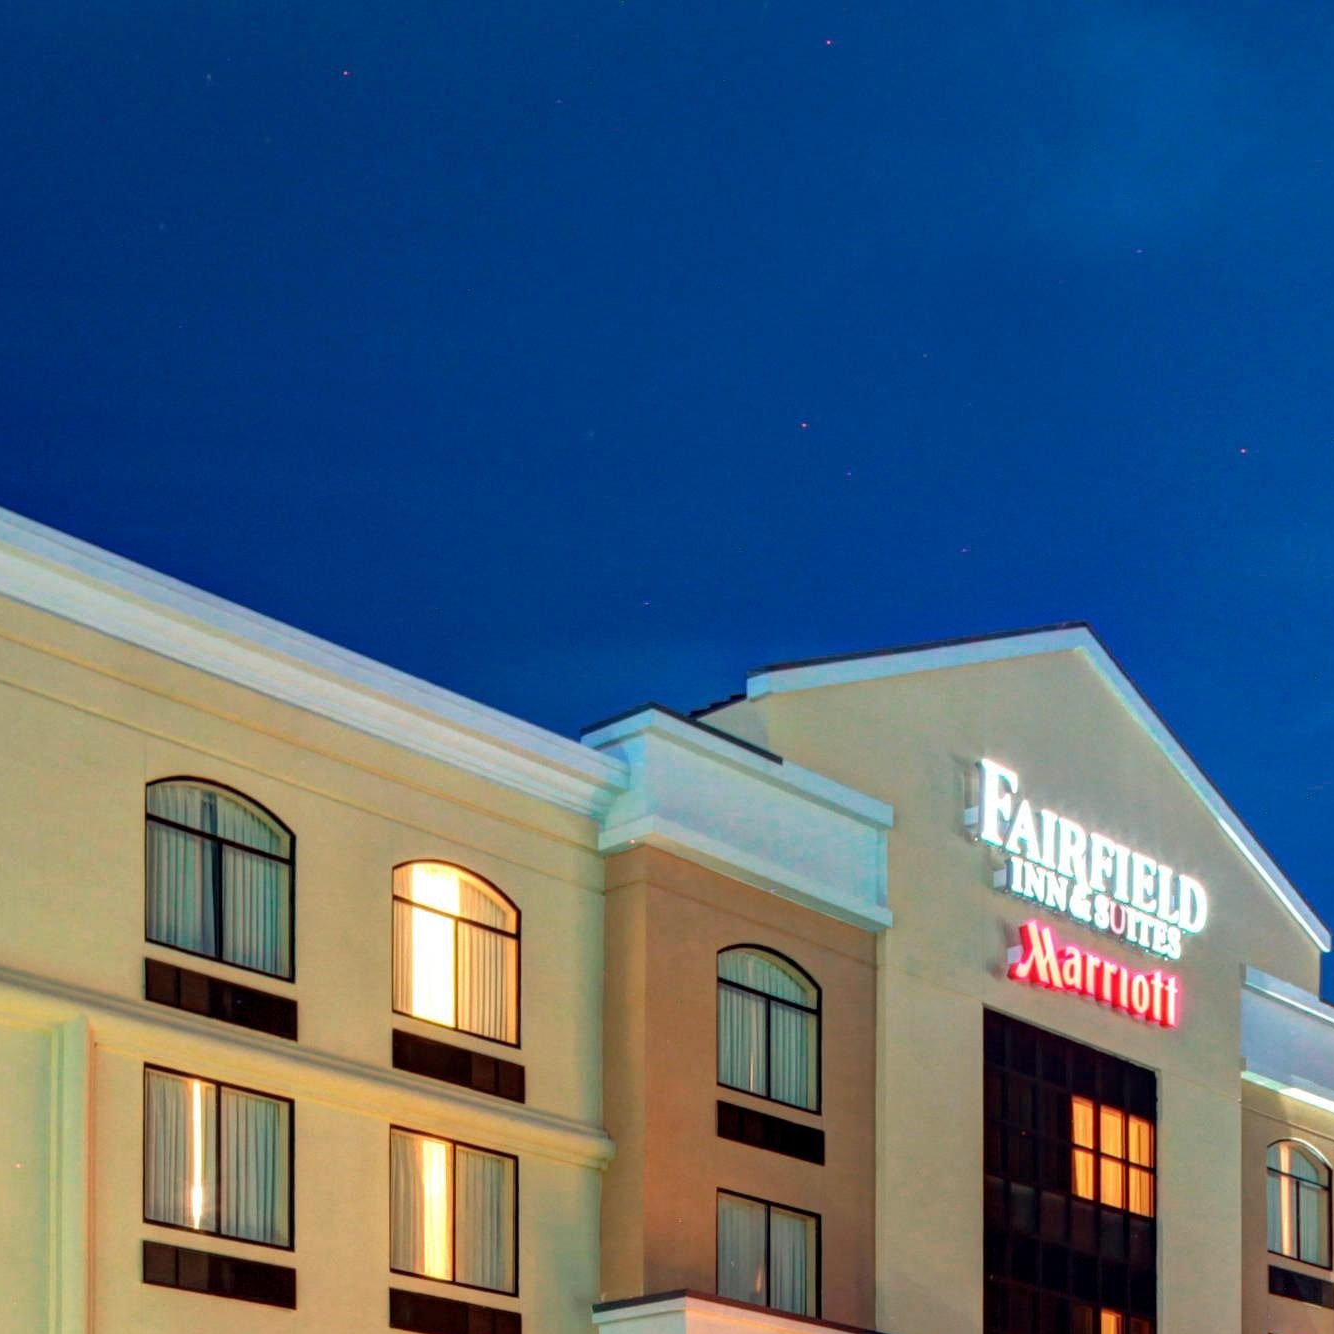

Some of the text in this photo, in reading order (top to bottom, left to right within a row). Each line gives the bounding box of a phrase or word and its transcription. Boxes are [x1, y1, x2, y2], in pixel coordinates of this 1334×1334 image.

[977, 757, 1208, 934] FAIRFIELD
[1010, 856, 1182, 960] INN & SUITES
[1009, 919, 1179, 1027] Marriott
